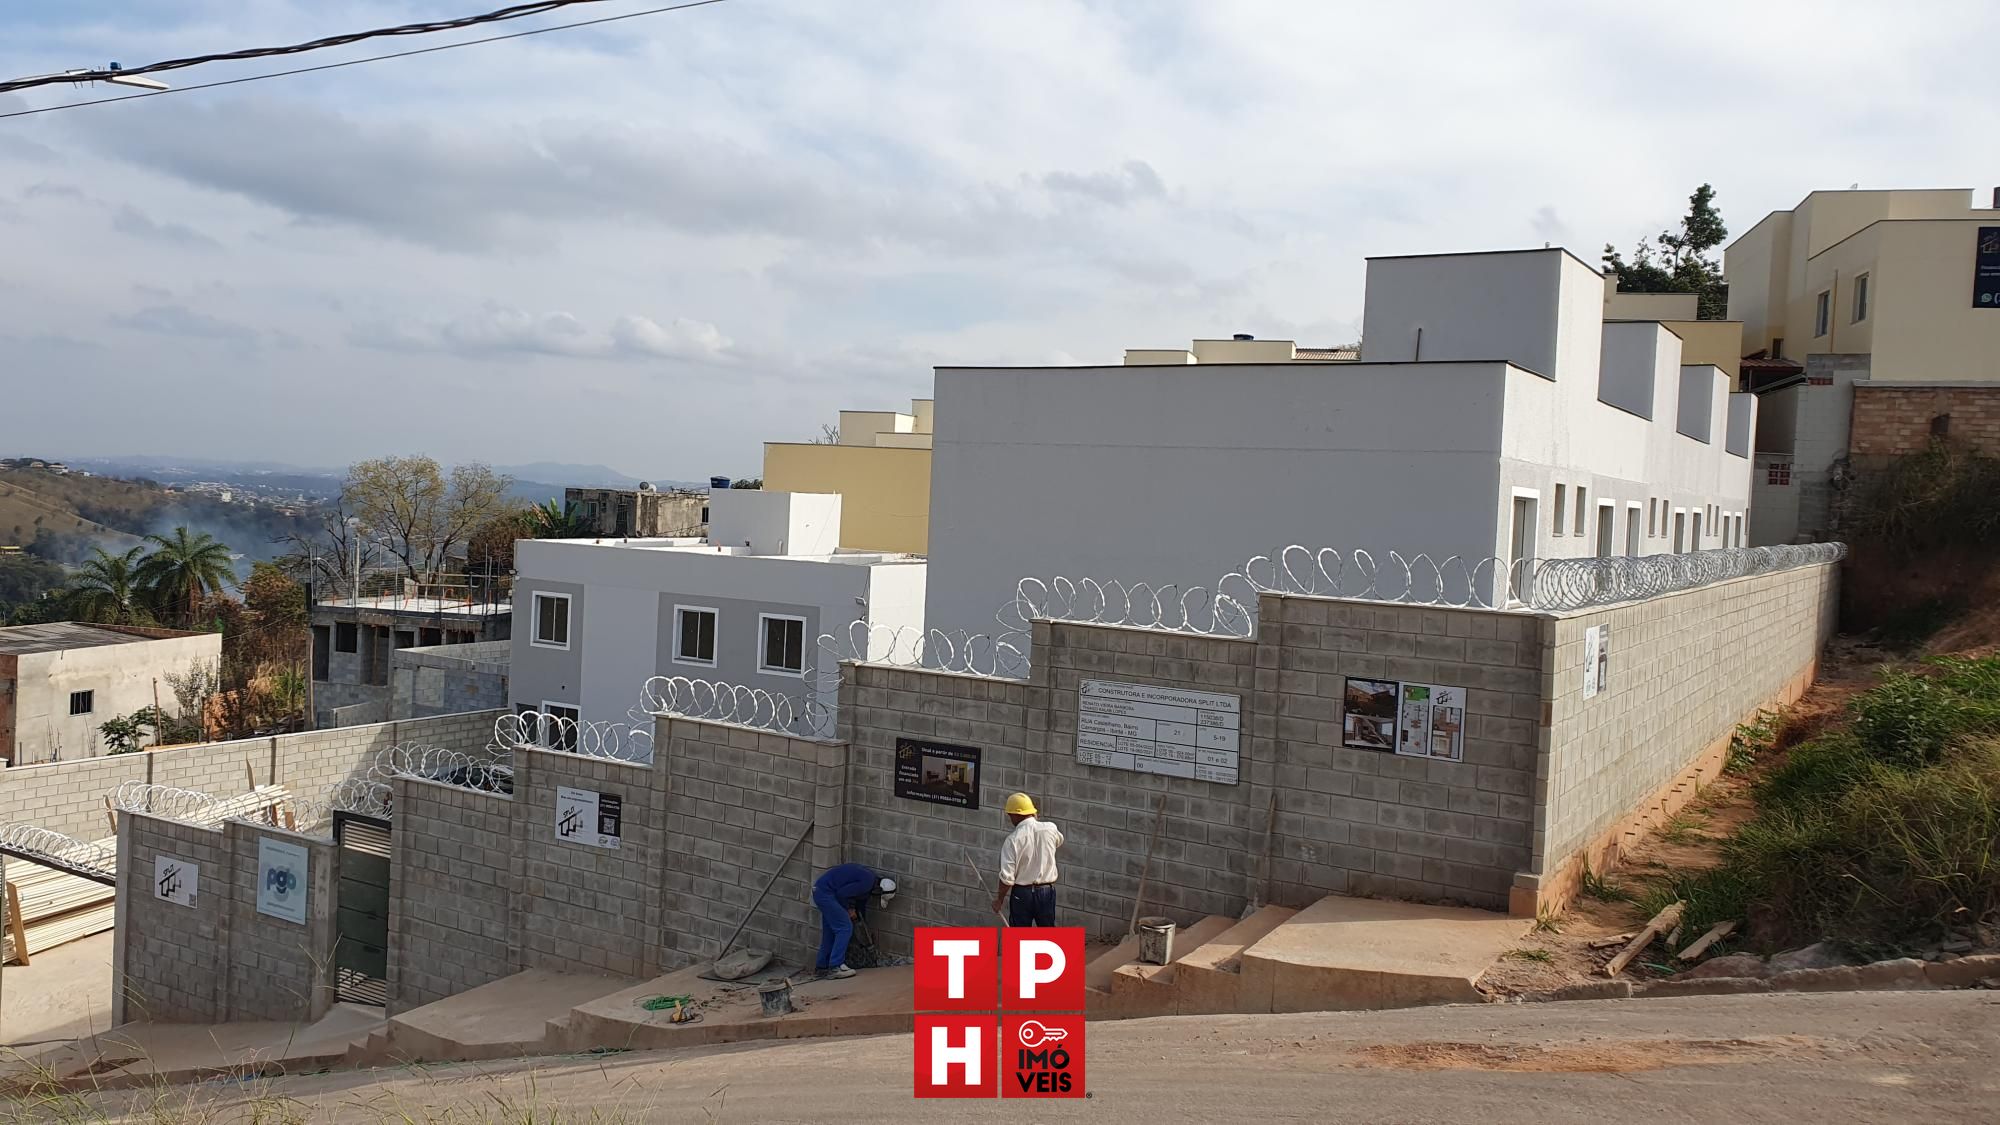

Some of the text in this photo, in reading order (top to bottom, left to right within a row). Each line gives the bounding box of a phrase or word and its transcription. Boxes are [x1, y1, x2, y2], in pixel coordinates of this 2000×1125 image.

[1097, 687, 1140, 698] CONSTRUTORA
[1146, 692, 1196, 704] INCORPORADORA
[1198, 698, 1214, 706] SPLIT
[1215, 700, 1231, 708] LTDA
[1079, 738, 1115, 748] RESIDENCIAL
